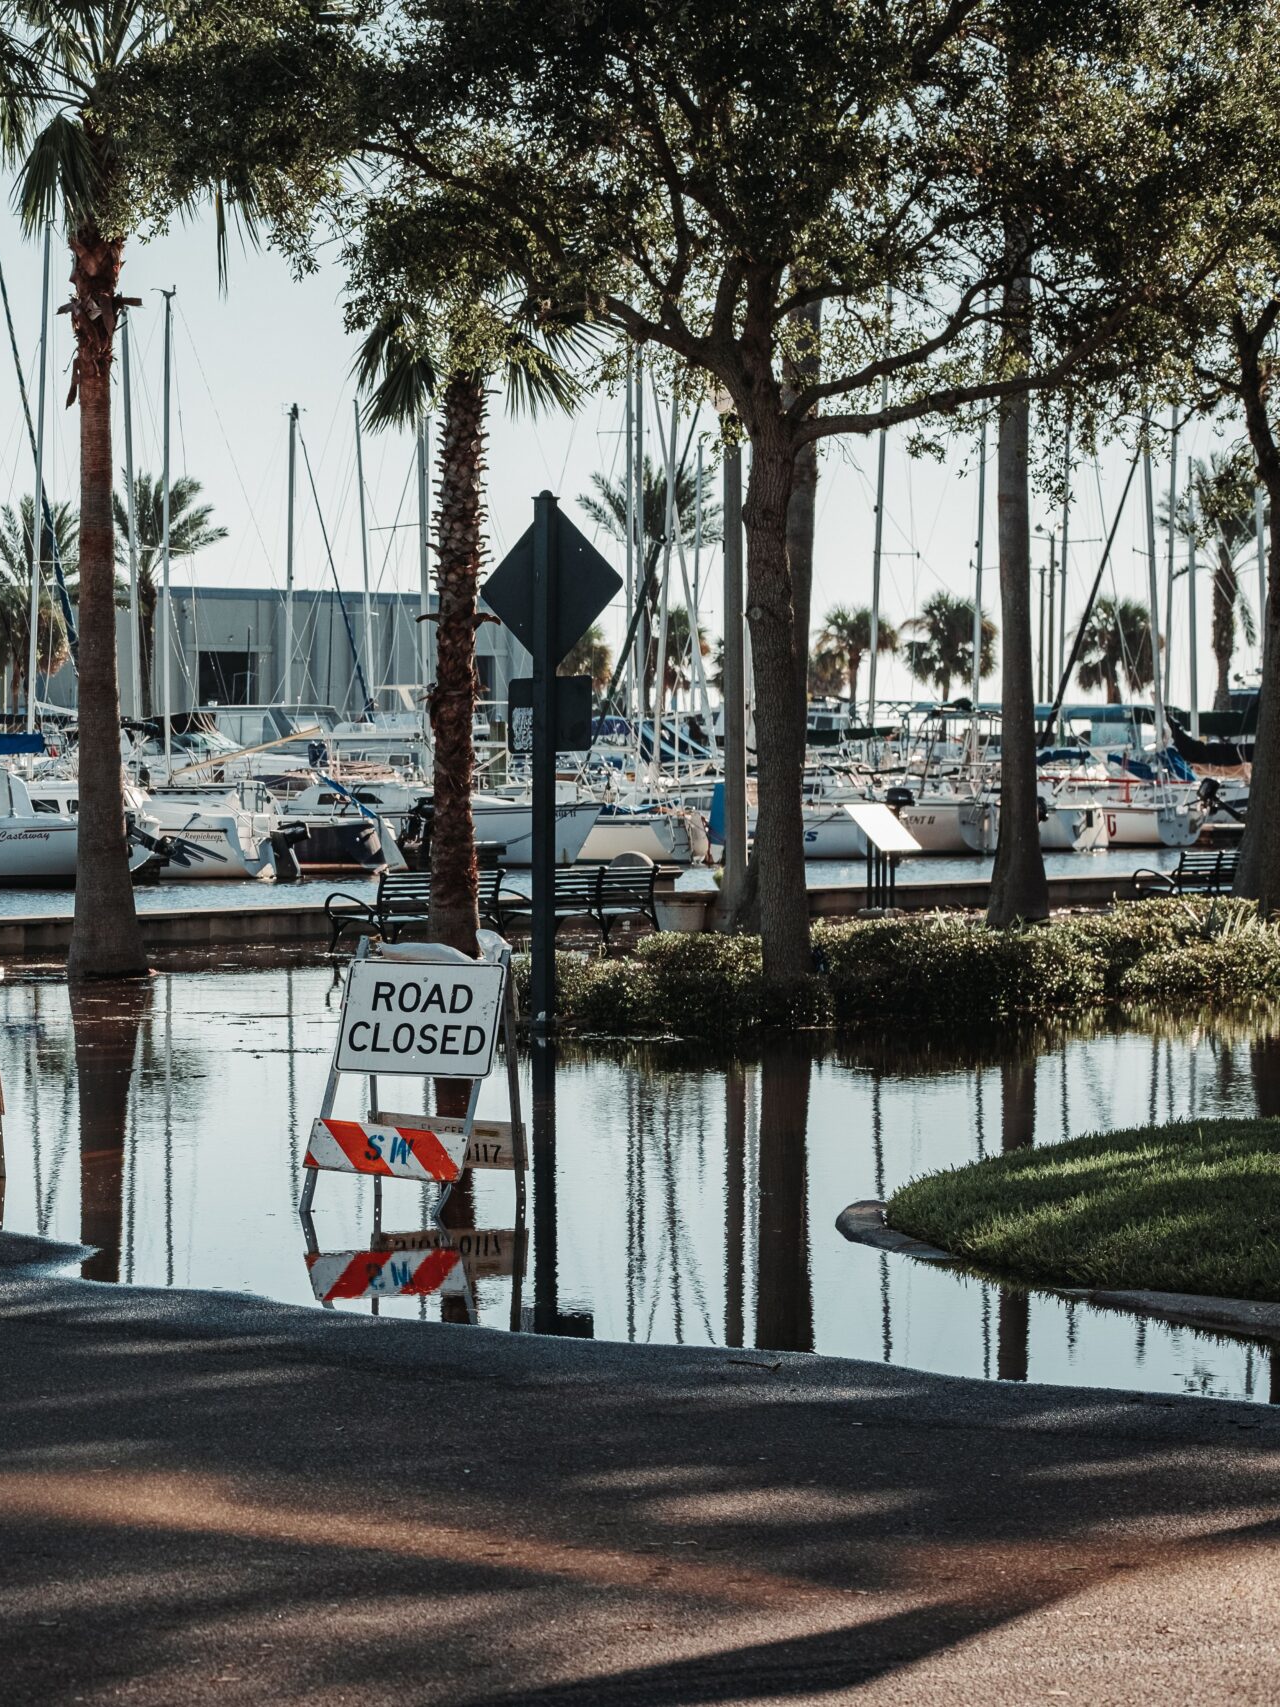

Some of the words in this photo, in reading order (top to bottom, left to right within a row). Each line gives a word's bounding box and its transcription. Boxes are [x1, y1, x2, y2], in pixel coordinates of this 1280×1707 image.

[184, 832, 222, 843] Reepicheep
[371, 981, 474, 1014] ROAD
[348, 1020, 486, 1056] CLOSED
